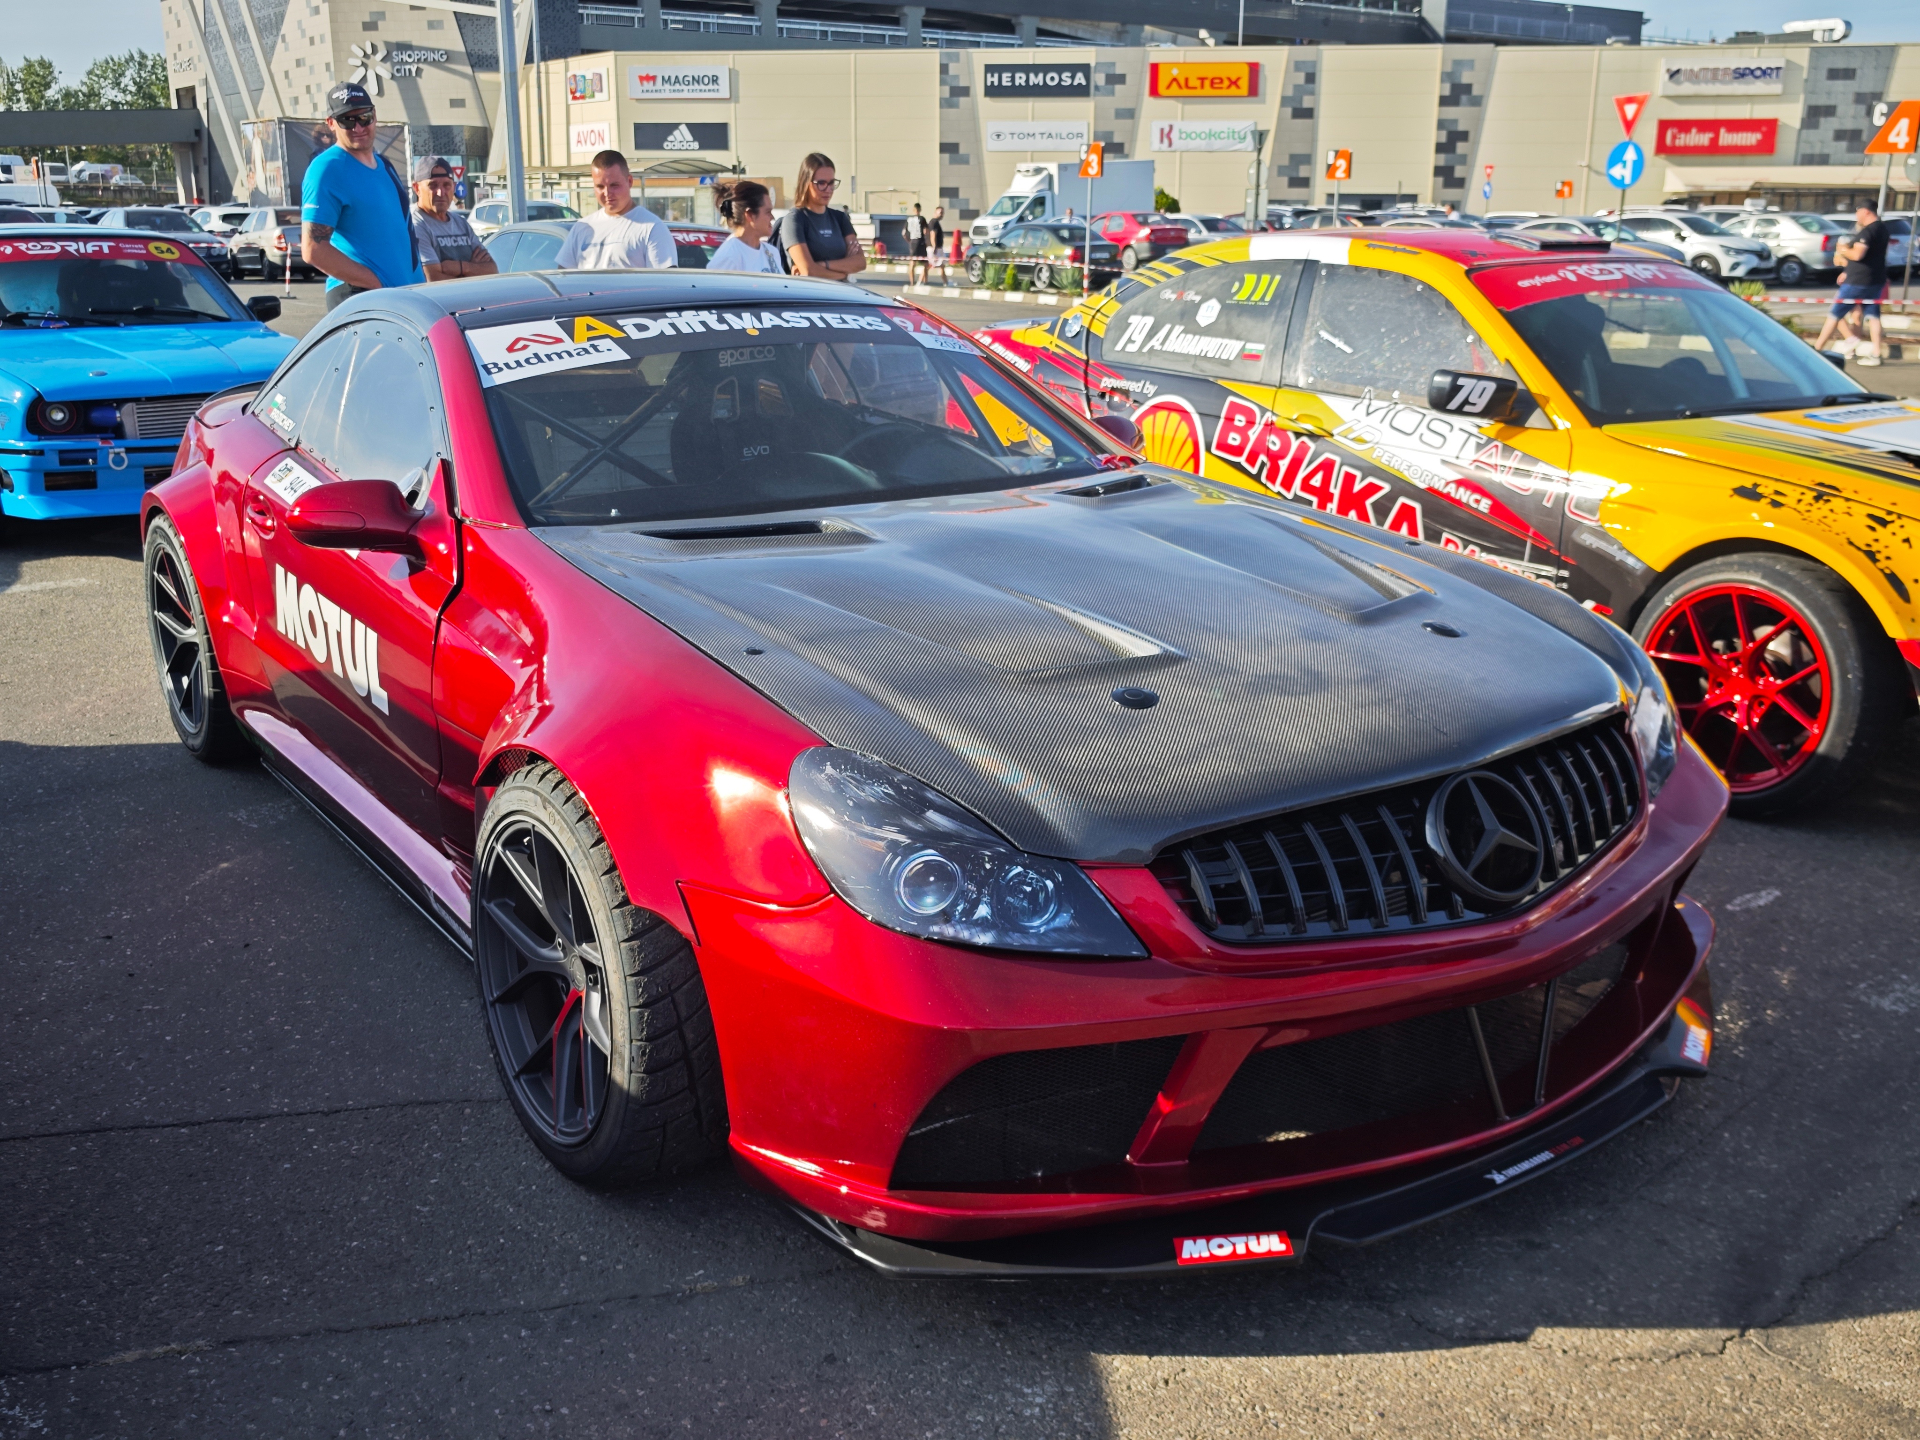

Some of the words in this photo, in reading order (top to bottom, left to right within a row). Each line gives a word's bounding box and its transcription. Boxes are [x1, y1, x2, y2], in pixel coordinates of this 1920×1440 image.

[392, 50, 448, 63] SHOPPING
[392, 64, 419, 78] CITY
[661, 75, 720, 86] MAGNOR
[986, 72, 1087, 87] HERMOSA
[1682, 67, 1783, 81] INTERSPORT
[1872, 102, 1889, 127] C
[576, 129, 605, 147] AVON
[1009, 132, 1040, 140] TOM
[1041, 132, 1084, 140] TAILOR
[1178, 127, 1248, 145] bookcity
[1665, 127, 1716, 147] Cador
[1718, 127, 1763, 147] home
[1886, 117, 1910, 150] 4
[663, 140, 699, 150] adidas
[1087, 153, 1099, 176] 3
[1334, 158, 1347, 178] 2
[438, 235, 472, 247] DUCATI
[671, 231, 709, 244] RIFT
[13, 241, 117, 257] RODRIFT
[154, 245, 176, 256] 54
[1114, 314, 1155, 353] 79
[481, 342, 613, 376] Budmat.
[718, 345, 776, 366] sparco
[1100, 377, 1145, 394] powered
[1143, 380, 1159, 398] by
[1446, 376, 1497, 414] 79
[743, 445, 770, 457] EVO
[1211, 395, 1425, 541] BRI4KA
[1371, 446, 1493, 515] PERFORMANCE
[275, 562, 390, 717] MOTUL
[1181, 1233, 1288, 1259] MOTUL
